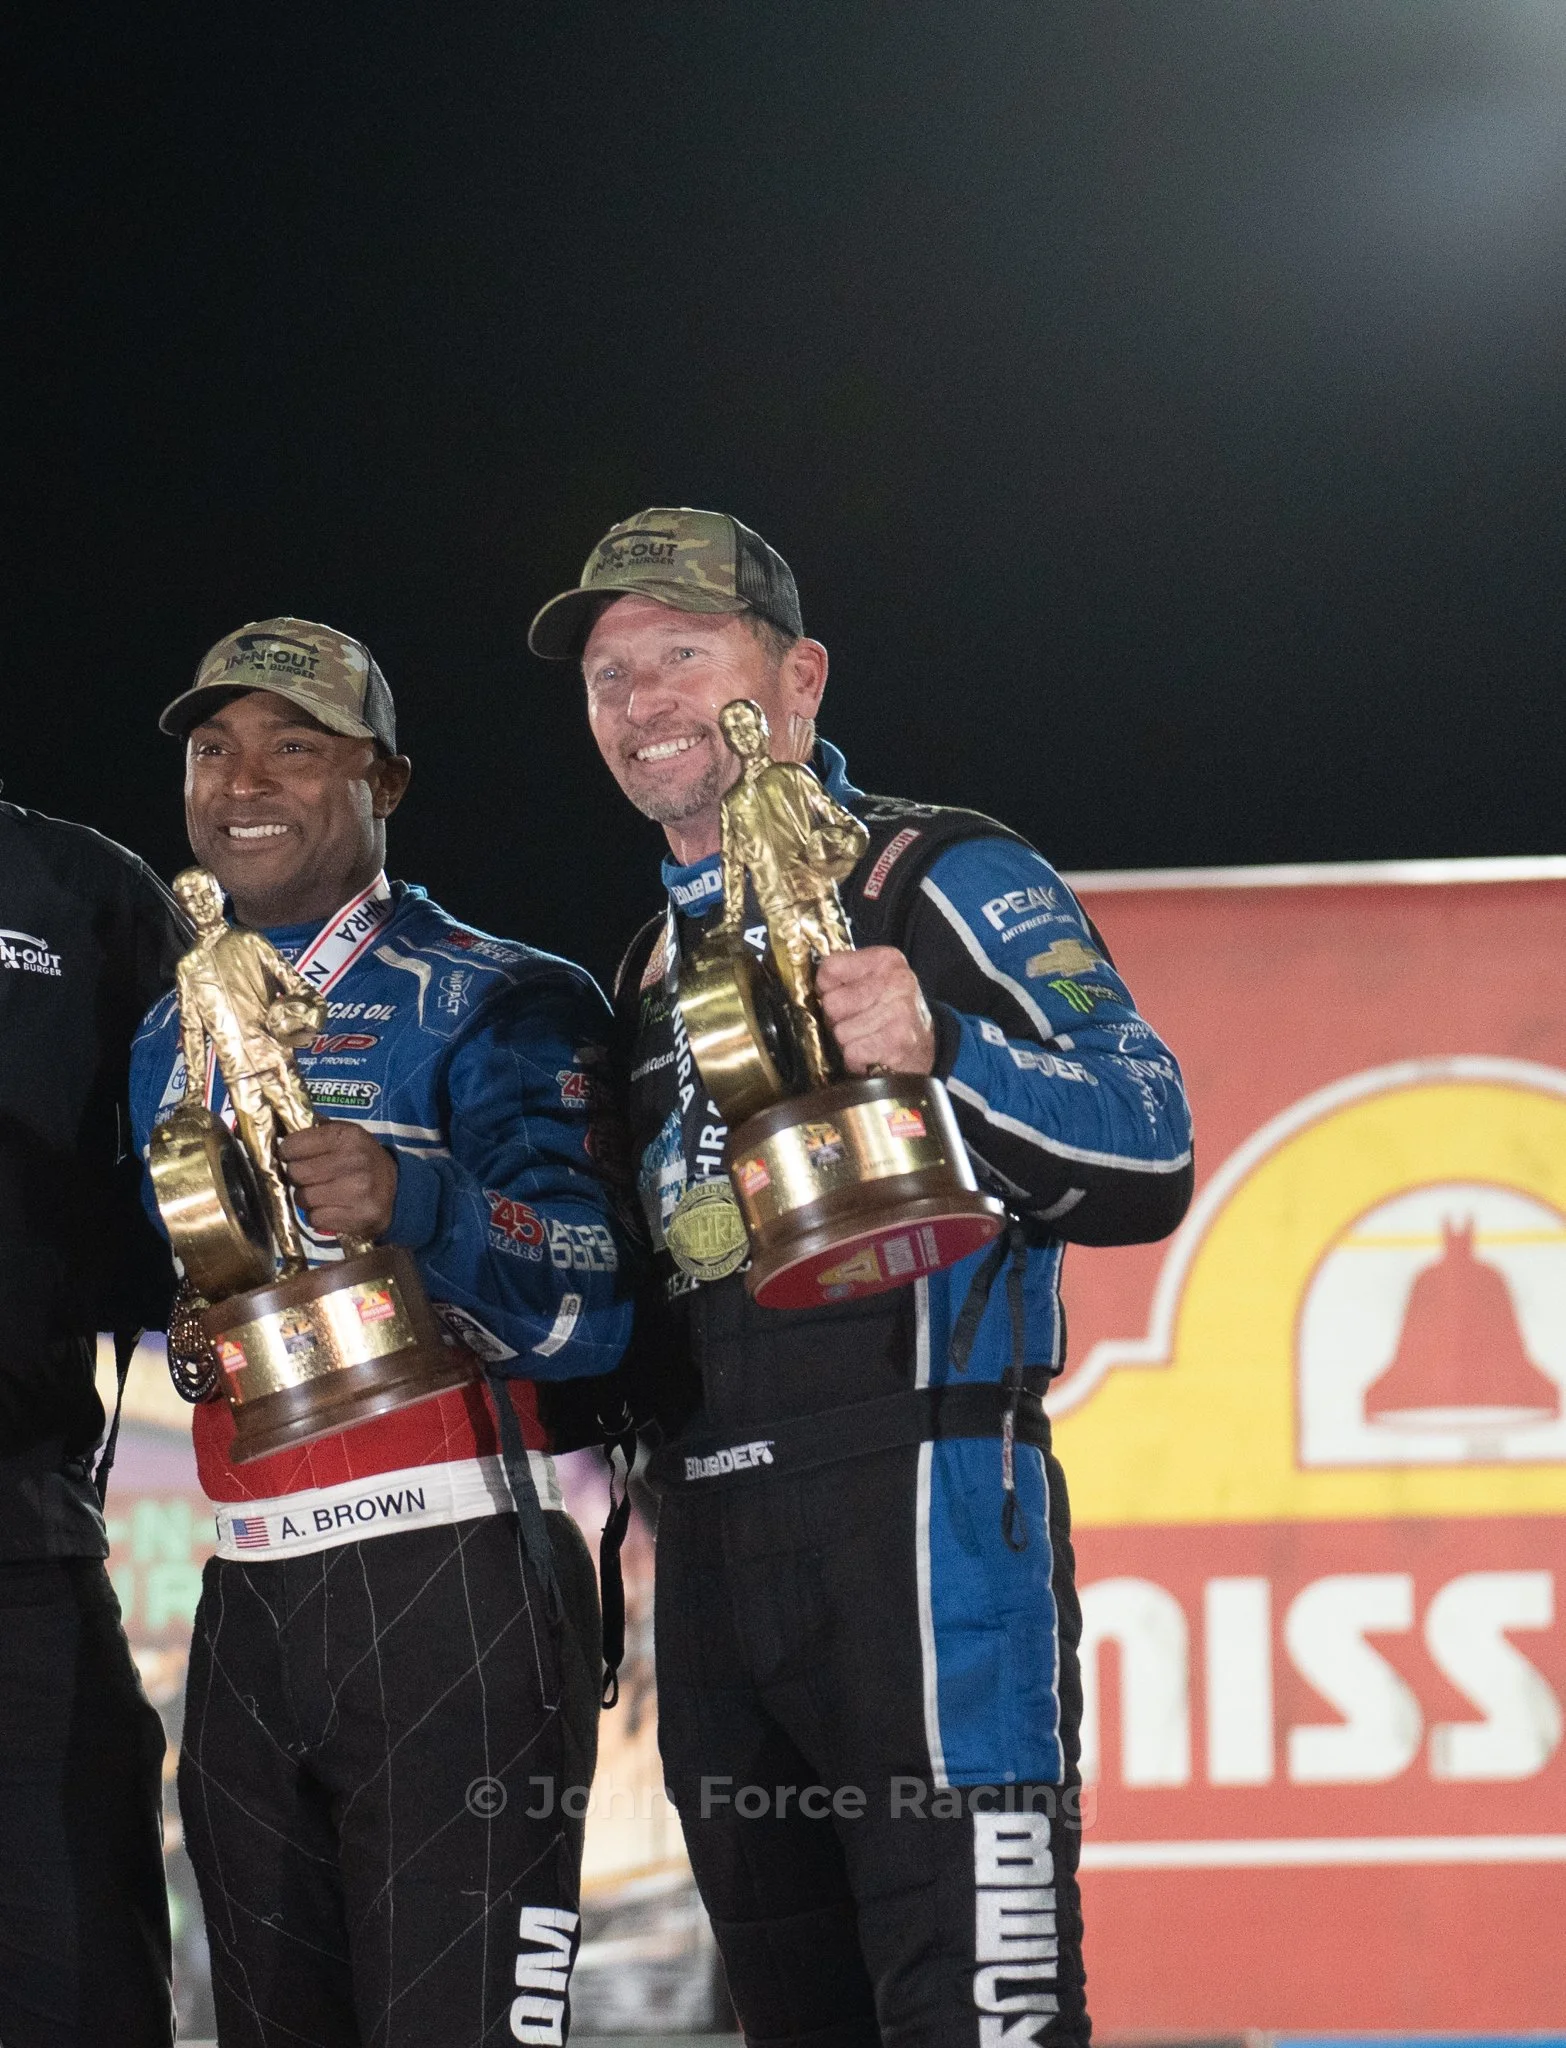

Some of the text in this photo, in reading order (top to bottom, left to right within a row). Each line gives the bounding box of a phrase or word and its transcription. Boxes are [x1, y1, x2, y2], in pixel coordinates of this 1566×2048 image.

[225, 649, 320, 671] IN-N-OUT
[269, 663, 316, 680] BURGER
[868, 831, 913, 893] SIMPSON
[671, 866, 723, 905] BlueD
[335, 896, 388, 944] NHRA
[980, 886, 1060, 931] PEAK
[23, 961, 62, 976] BURGER
[327, 1002, 397, 1020] CAS OIL
[316, 1094, 367, 1106] LUBRICANTS
[488, 1196, 545, 1247] 45
[488, 1228, 543, 1263] YEARS
[550, 1240, 619, 1272] OOLS
[281, 1487, 426, 1540] A. BROWN
